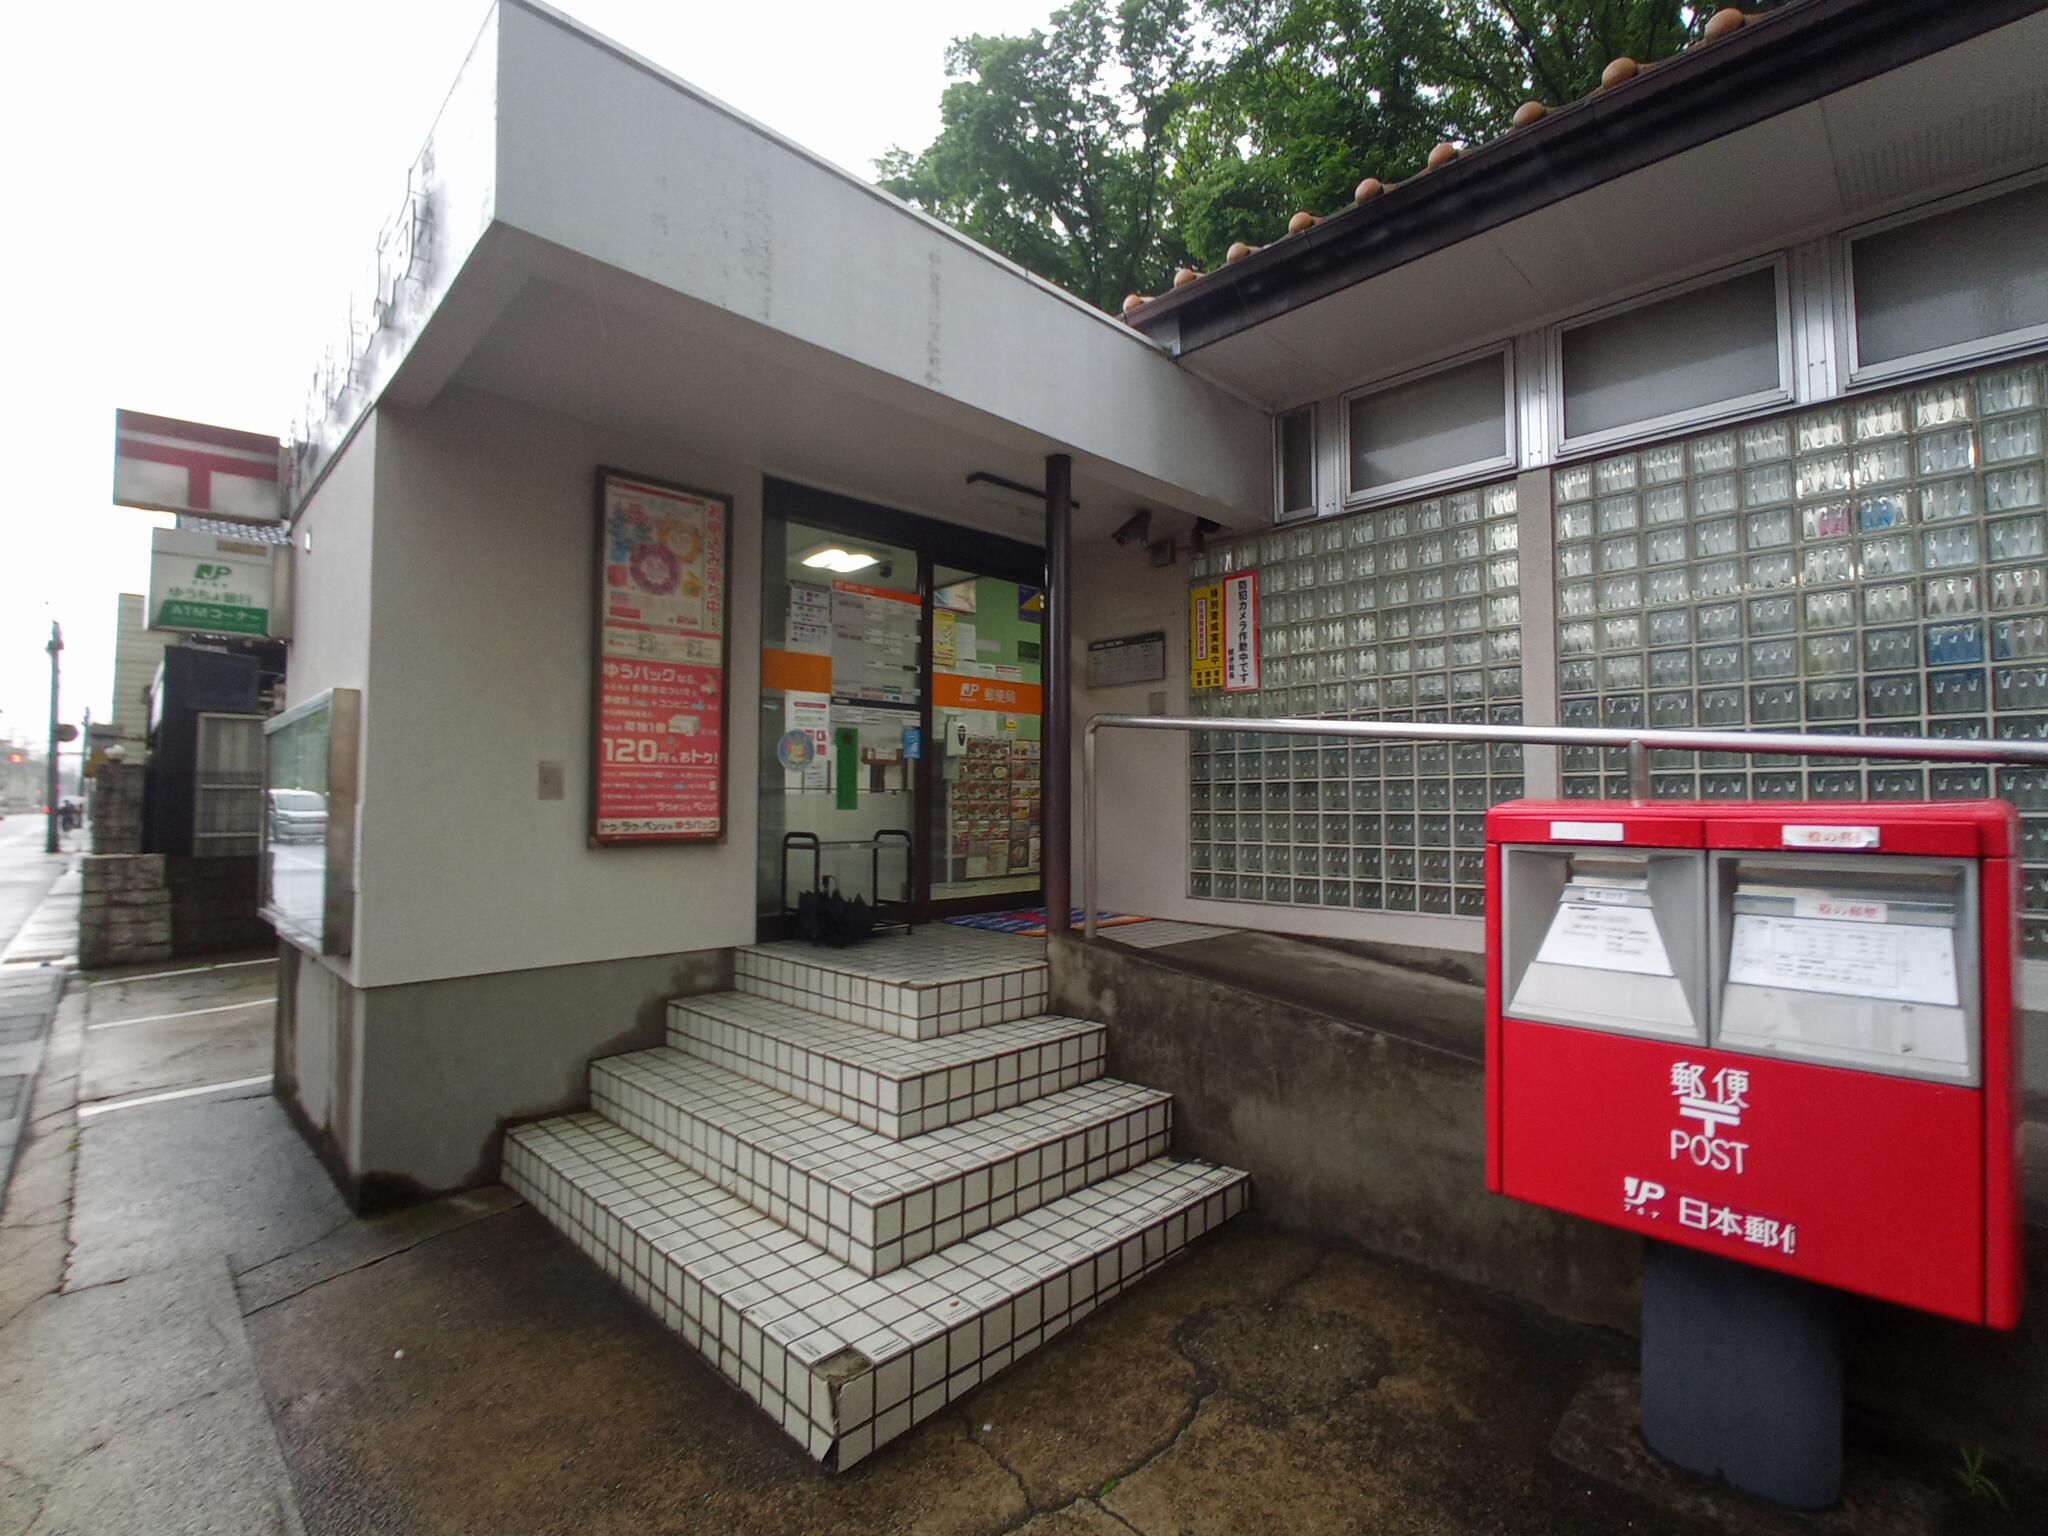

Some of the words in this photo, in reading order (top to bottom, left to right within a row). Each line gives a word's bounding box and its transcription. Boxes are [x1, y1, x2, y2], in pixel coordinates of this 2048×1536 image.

[169, 587, 252, 606] ゆうちょ銀行
[170, 605, 261, 621] ATMコーナー
[1238, 579, 1249, 684] 防犯カメラ作動中です
[983, 689, 1017, 704] 郵便局
[1670, 1061, 1750, 1109] 郵便
[1670, 1130, 1750, 1175] POST
